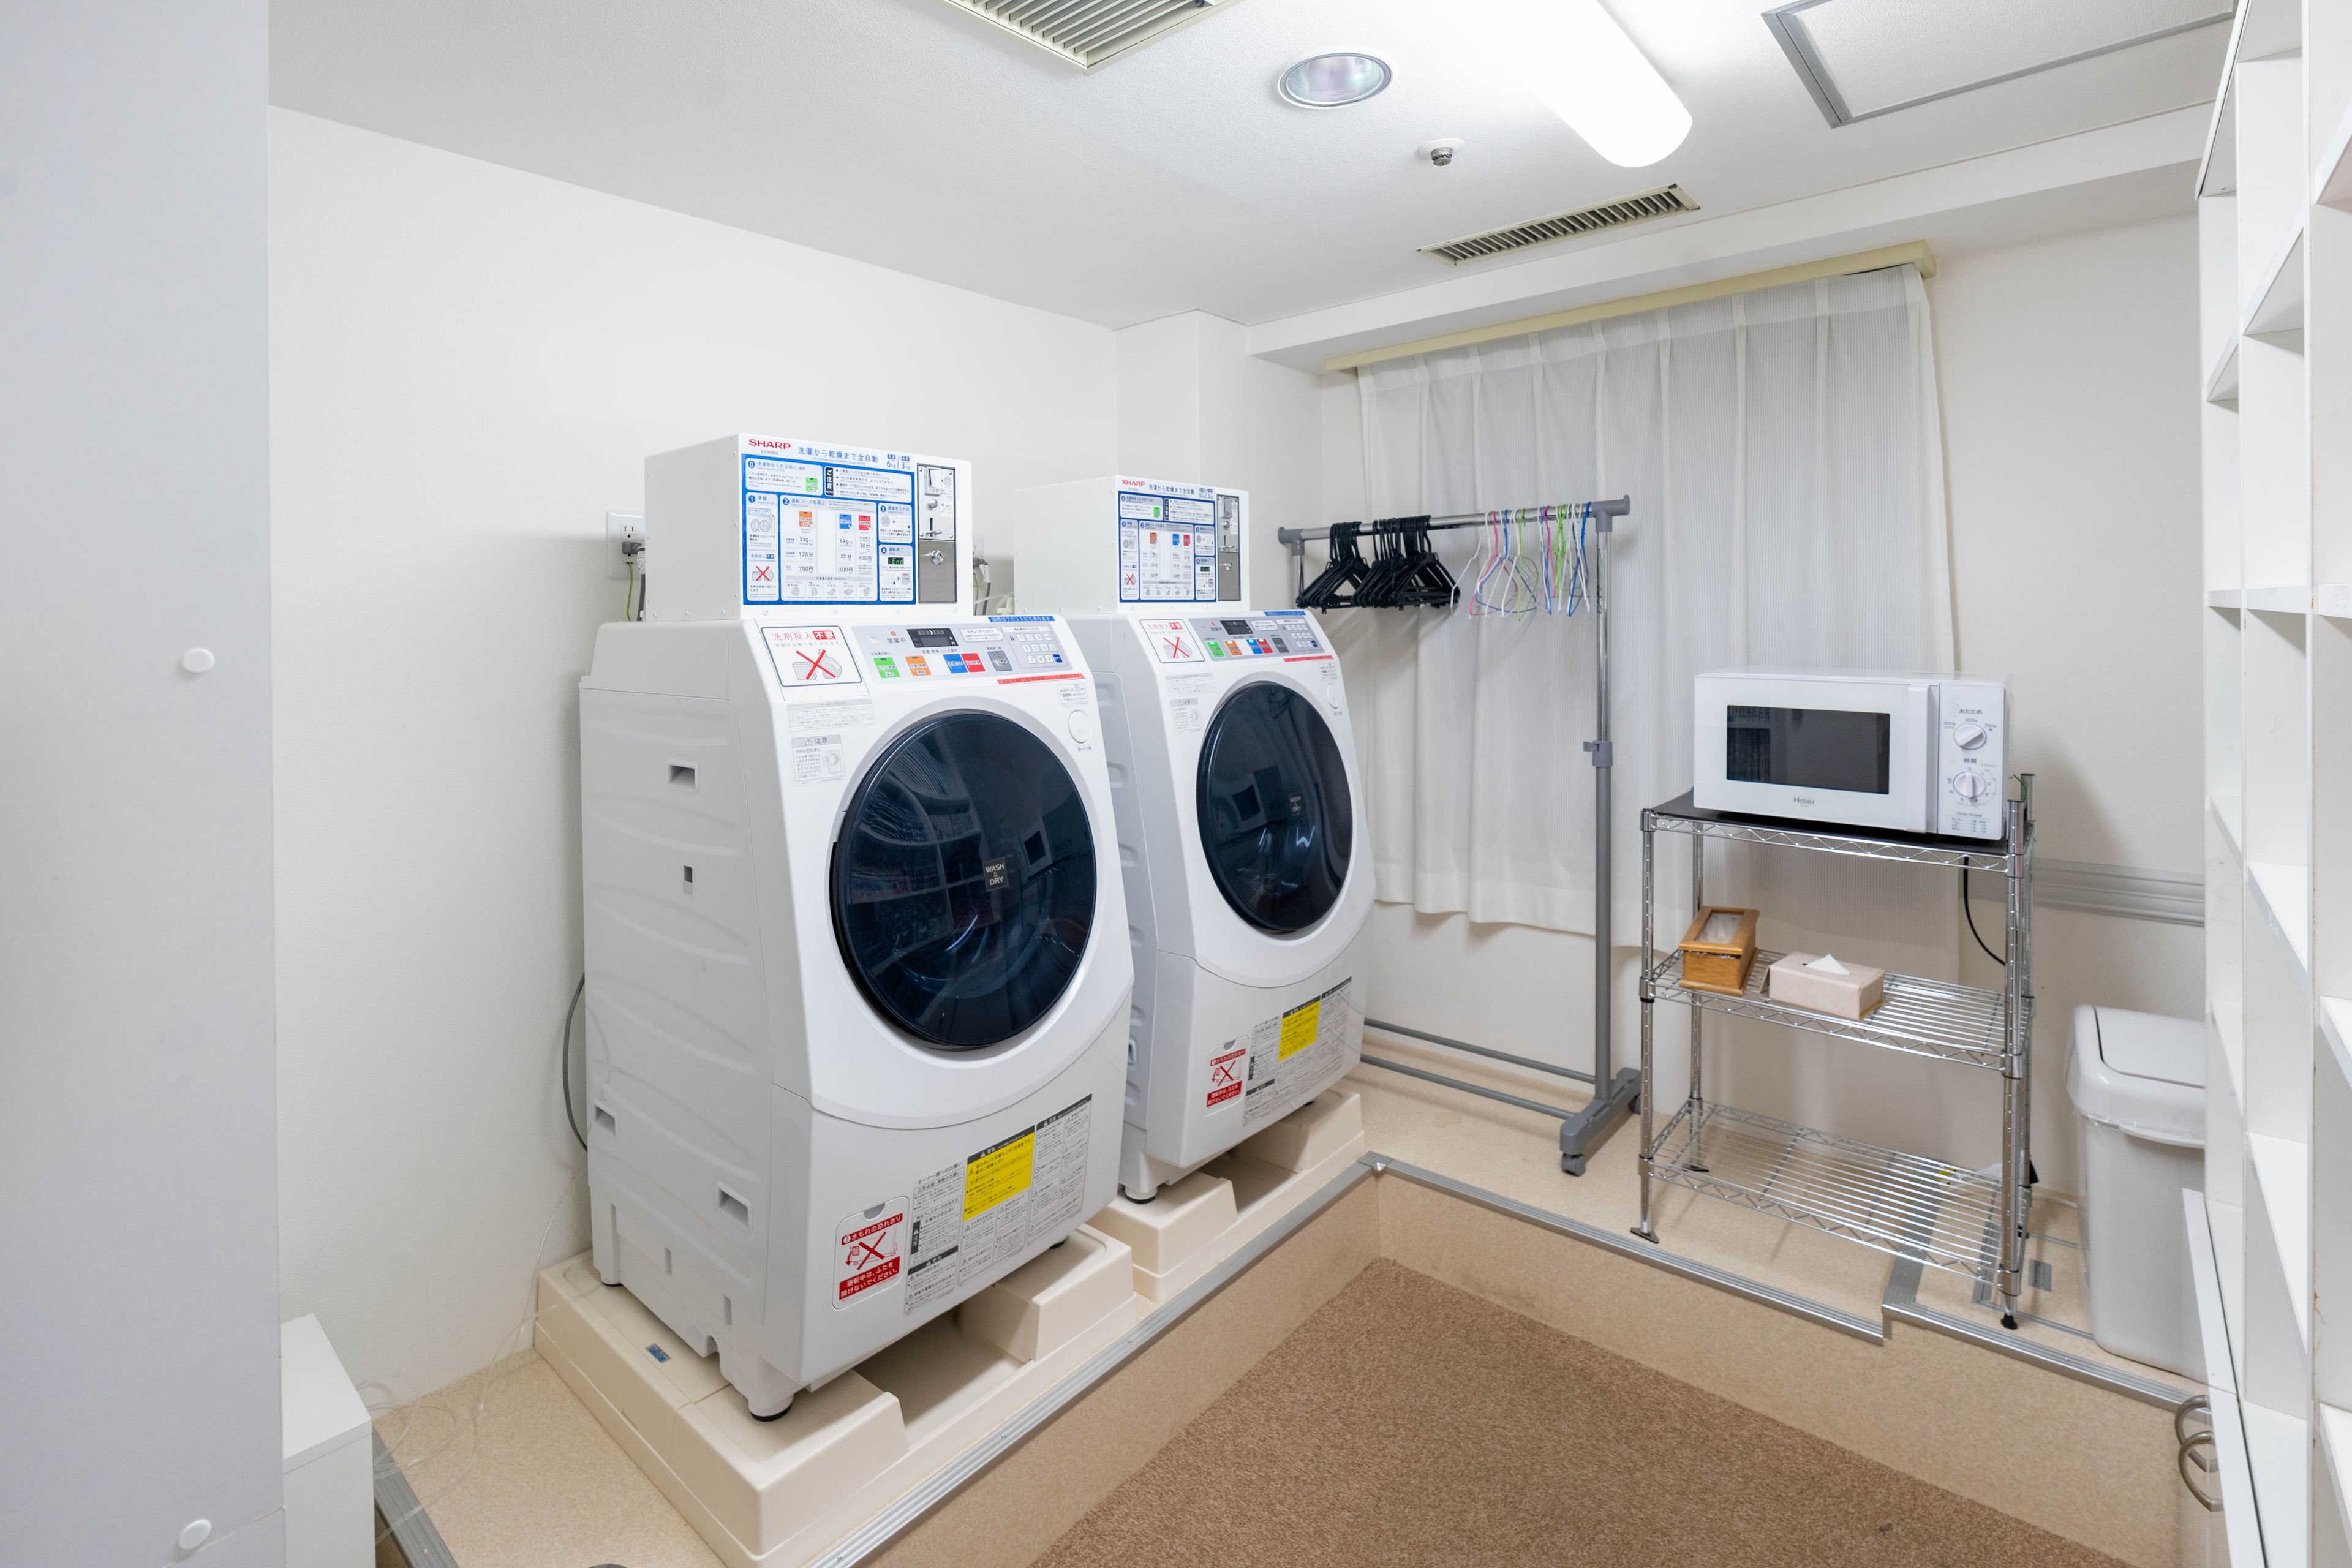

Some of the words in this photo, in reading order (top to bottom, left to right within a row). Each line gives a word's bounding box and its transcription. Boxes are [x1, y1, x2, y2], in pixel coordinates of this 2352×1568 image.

[748, 439, 791, 450] SHARP
[798, 446, 878, 463] 洗濯から乾燥まで全自動
[773, 631, 813, 641] 洗剤投入
[815, 631, 835, 639] 不要
[985, 863, 1005, 873] WASH
[989, 876, 1003, 886] DRY
[851, 1215, 902, 1240] 水もれの恐れあり
[846, 1262, 894, 1287] 運転中は、ふたを
[840, 1270, 898, 1297] 開けないでください。
